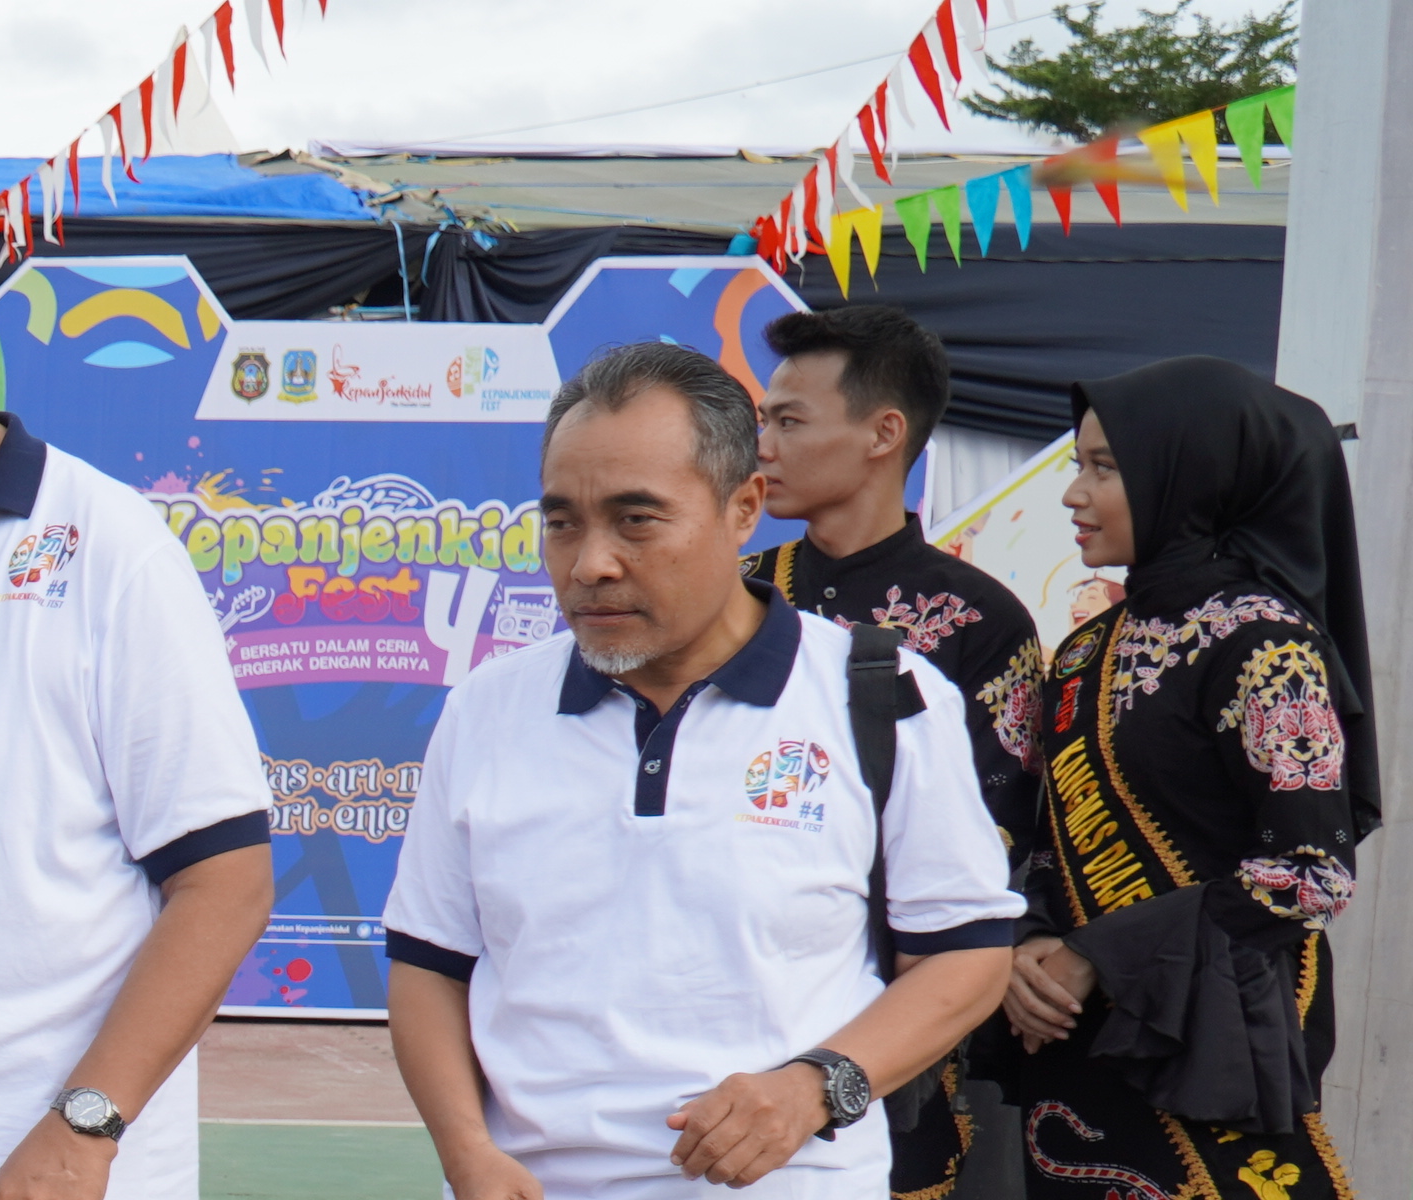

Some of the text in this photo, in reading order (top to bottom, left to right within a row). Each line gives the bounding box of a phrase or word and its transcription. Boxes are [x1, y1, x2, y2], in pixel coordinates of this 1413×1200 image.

[149, 500, 551, 586] epanjenkid
[273, 565, 421, 625] Fest
[233, 655, 430, 678] ERGERAK DENGAN KARYA
[240, 639, 420, 660] BERSATU DALAM CERIA
[326, 762, 380, 797] art
[1051, 735, 1118, 856] KANGMAS
[335, 803, 413, 840] ente
